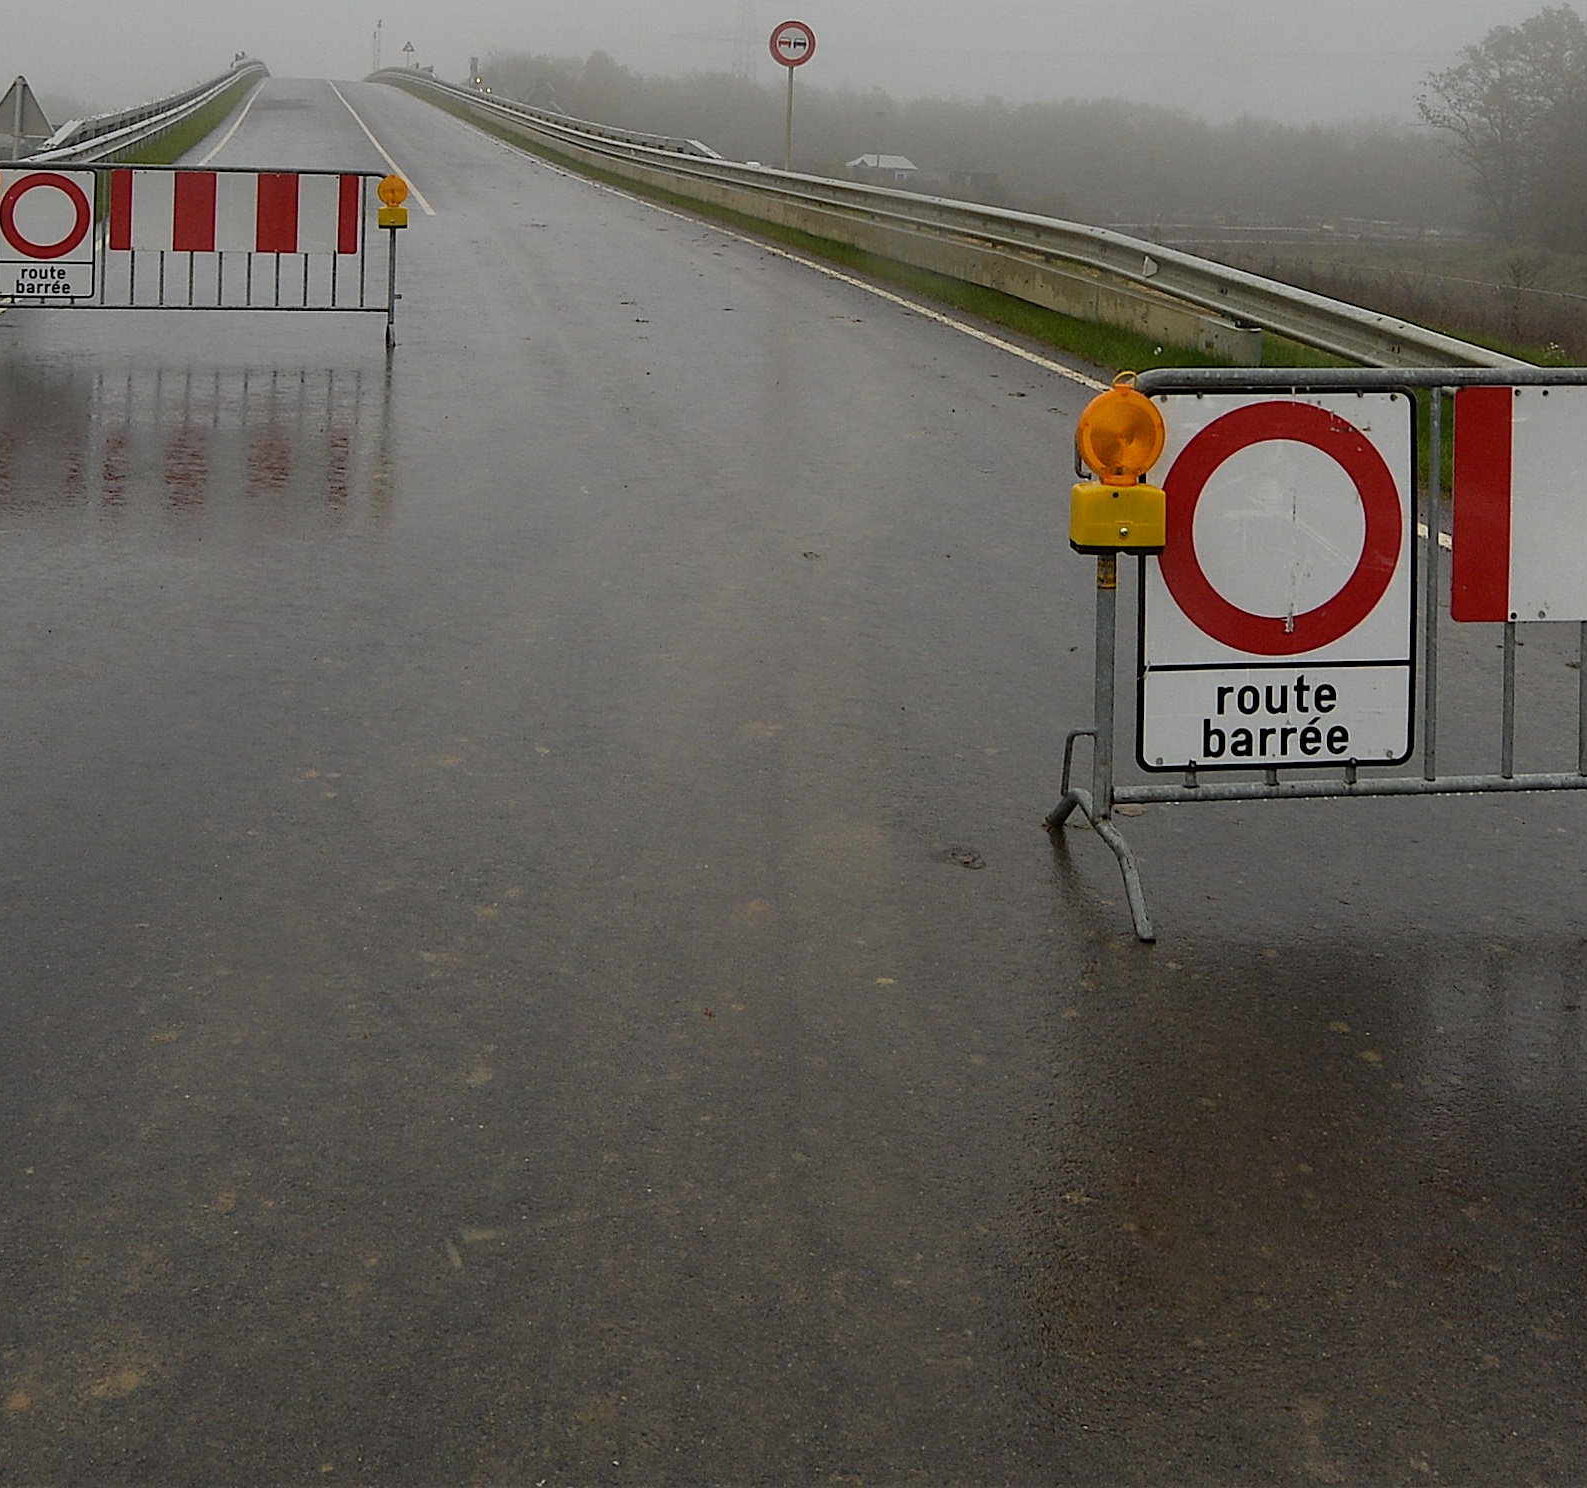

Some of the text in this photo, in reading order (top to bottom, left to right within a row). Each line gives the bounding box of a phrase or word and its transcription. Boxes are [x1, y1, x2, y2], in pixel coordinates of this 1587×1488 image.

[16, 279, 71, 294] barrée
[21, 266, 67, 280] route
[1217, 674, 1337, 715] route
[1202, 718, 1349, 758] barrée
